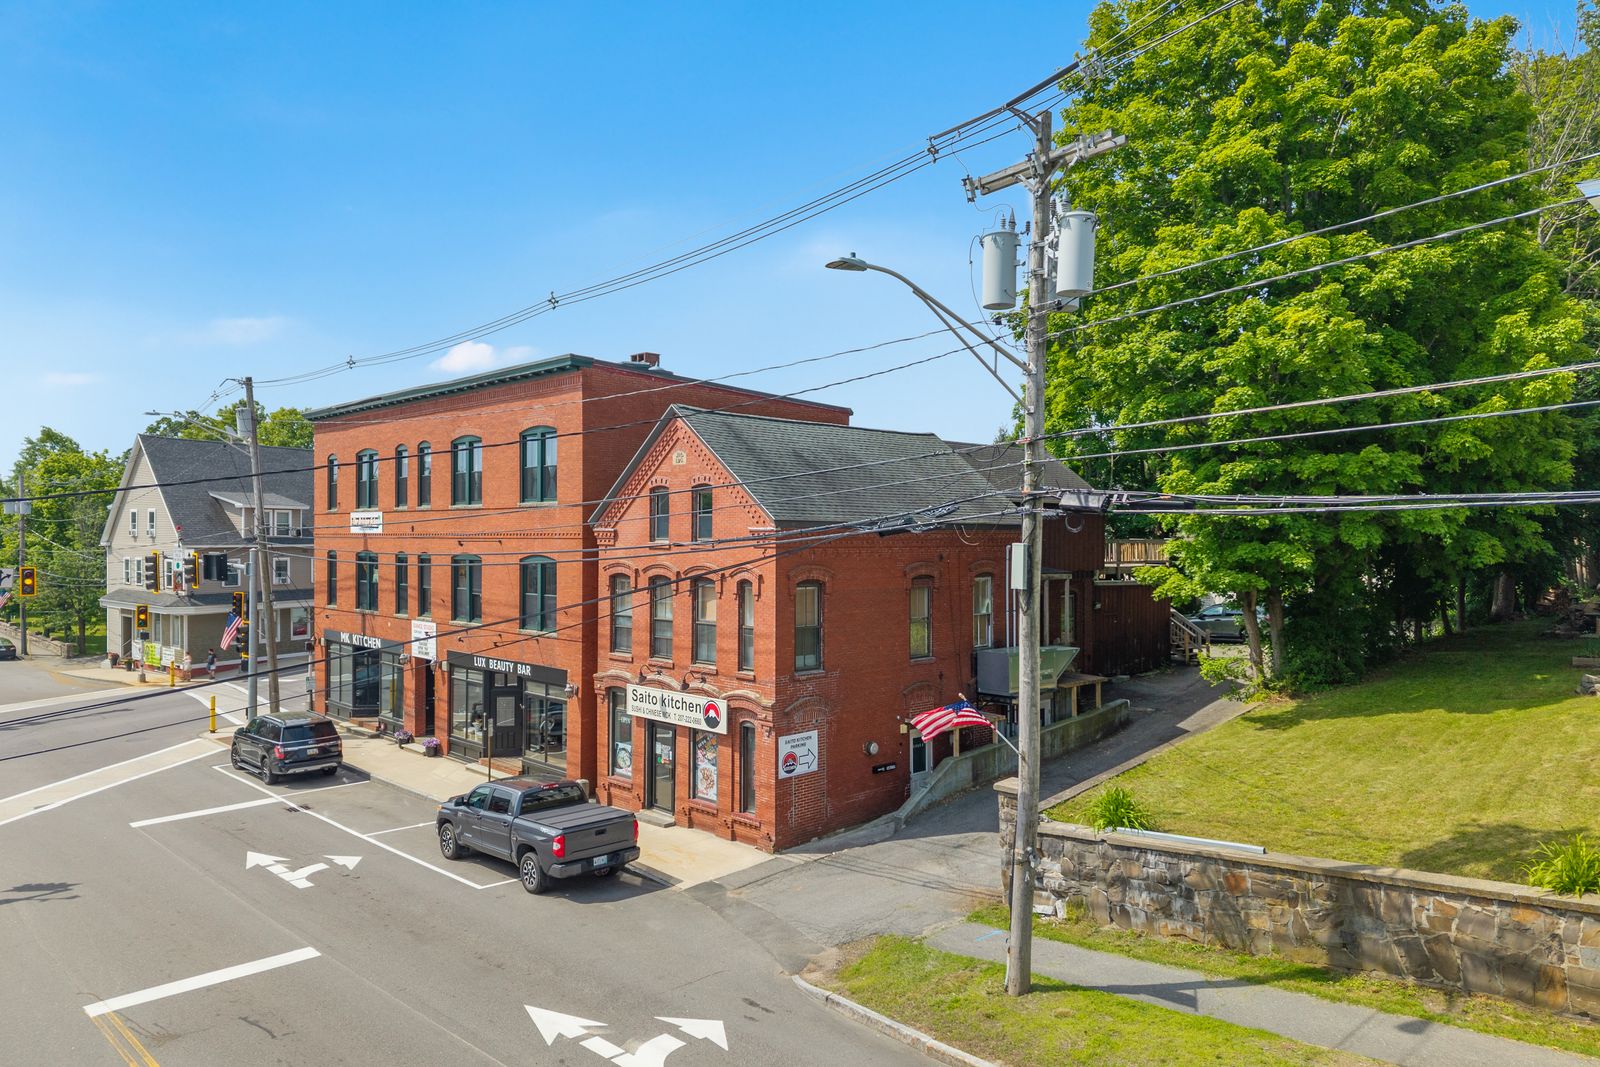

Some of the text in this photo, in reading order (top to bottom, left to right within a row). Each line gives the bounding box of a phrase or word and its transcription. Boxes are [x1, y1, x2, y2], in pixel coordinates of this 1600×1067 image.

[341, 631, 381, 648] MK KITCHEN
[474, 656, 531, 676] LUX BEAUTY BAR
[631, 688, 702, 713] Saito kitchen
[646, 707, 662, 717] CHINESE
